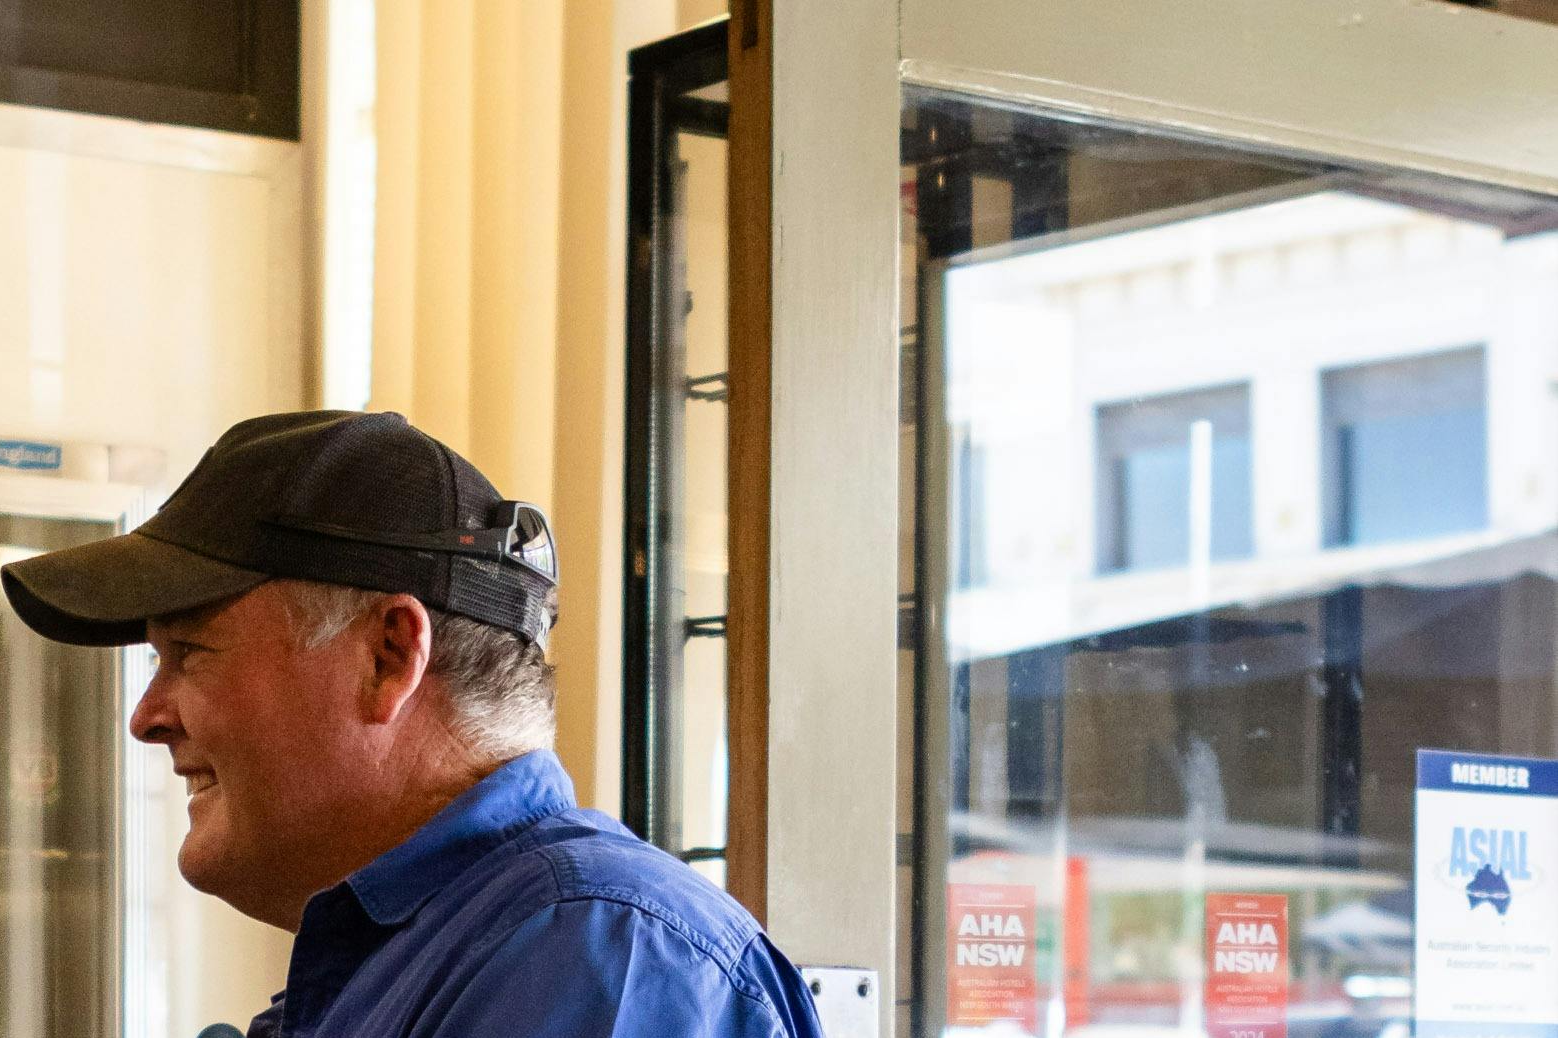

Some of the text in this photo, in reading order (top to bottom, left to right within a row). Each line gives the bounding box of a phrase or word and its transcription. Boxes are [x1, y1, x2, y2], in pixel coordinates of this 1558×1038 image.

[1451, 763, 1530, 788] MEMBER
[1449, 827, 1531, 880] ASIAL
[957, 914, 1025, 936] AHA
[1216, 922, 1279, 945] AHA
[955, 944, 1025, 967] NSW
[1215, 951, 1279, 973] NSW
